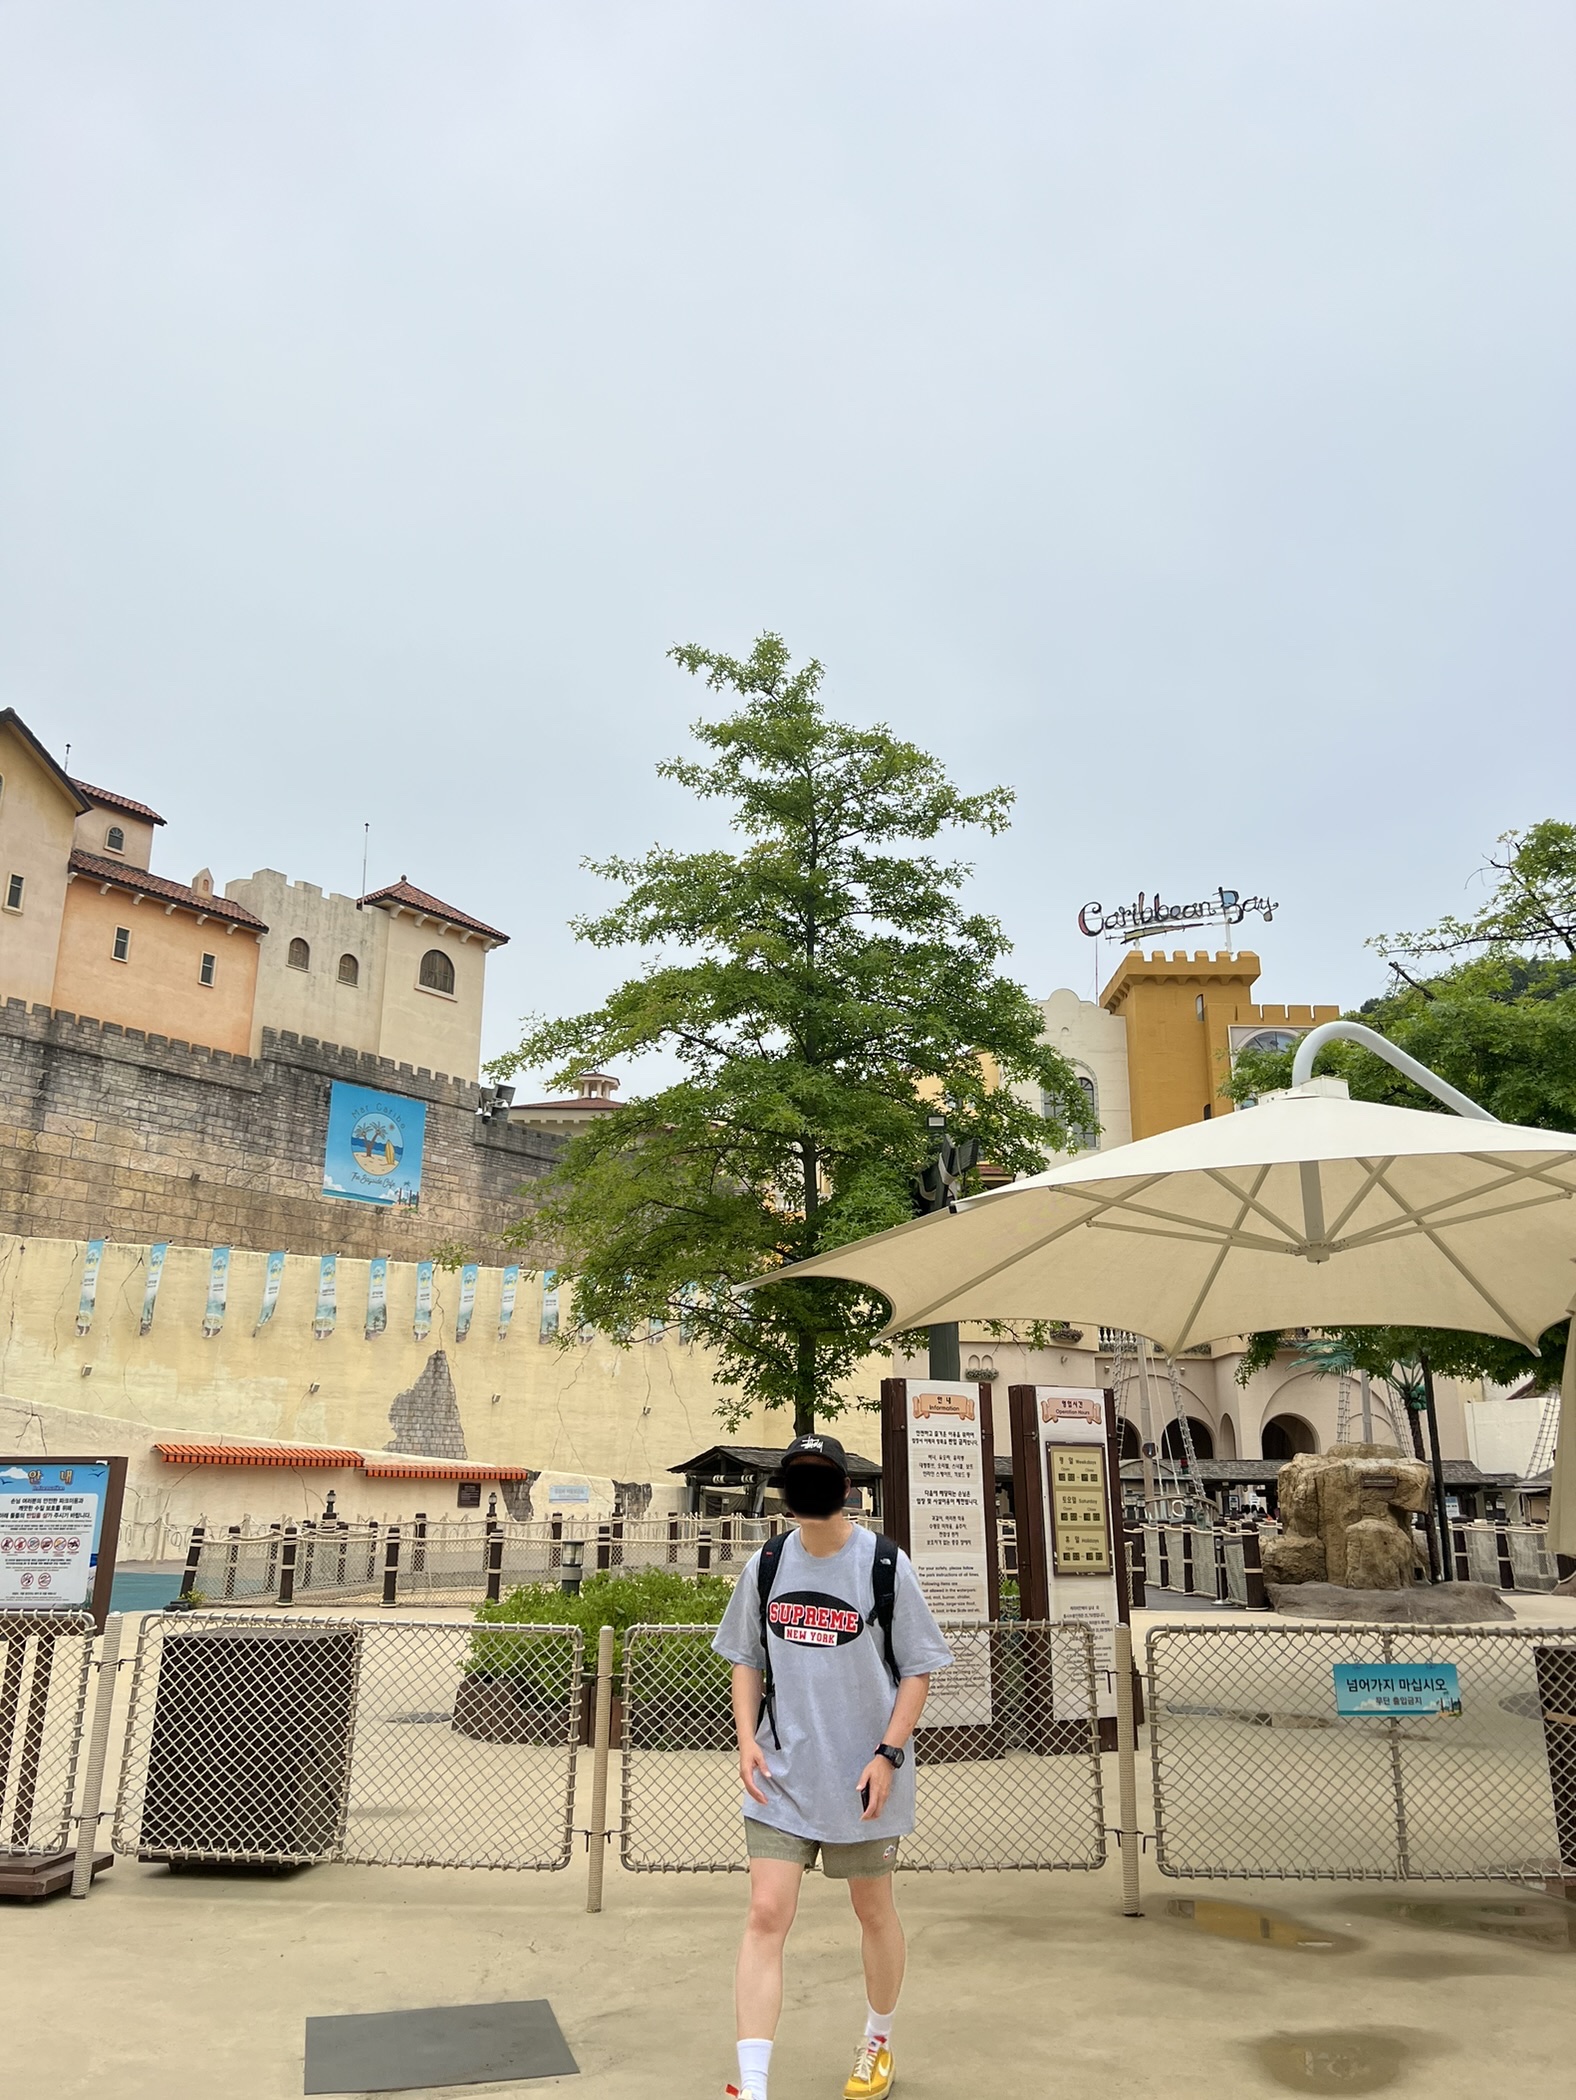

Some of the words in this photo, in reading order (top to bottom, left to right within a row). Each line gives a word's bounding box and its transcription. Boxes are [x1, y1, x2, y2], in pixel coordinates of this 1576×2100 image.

[1078, 891, 1216, 937] Caribbean
[1213, 886, 1279, 924] Bay
[352, 1105, 368, 1119] Mar
[28, 1470, 43, 1485] 안
[60, 1469, 74, 1485] 내
[1062, 1496, 1076, 1504] 토요일
[769, 1602, 859, 1634] SUPREME
[786, 1628, 807, 1640] NEW
[810, 1632, 835, 1644] YORK
[1346, 1678, 1395, 1692] 넘어가지
[1398, 1678, 1448, 1692] 마십시오
[1376, 1696, 1390, 1706] 무단
[1392, 1696, 1422, 1706] 출입금지
